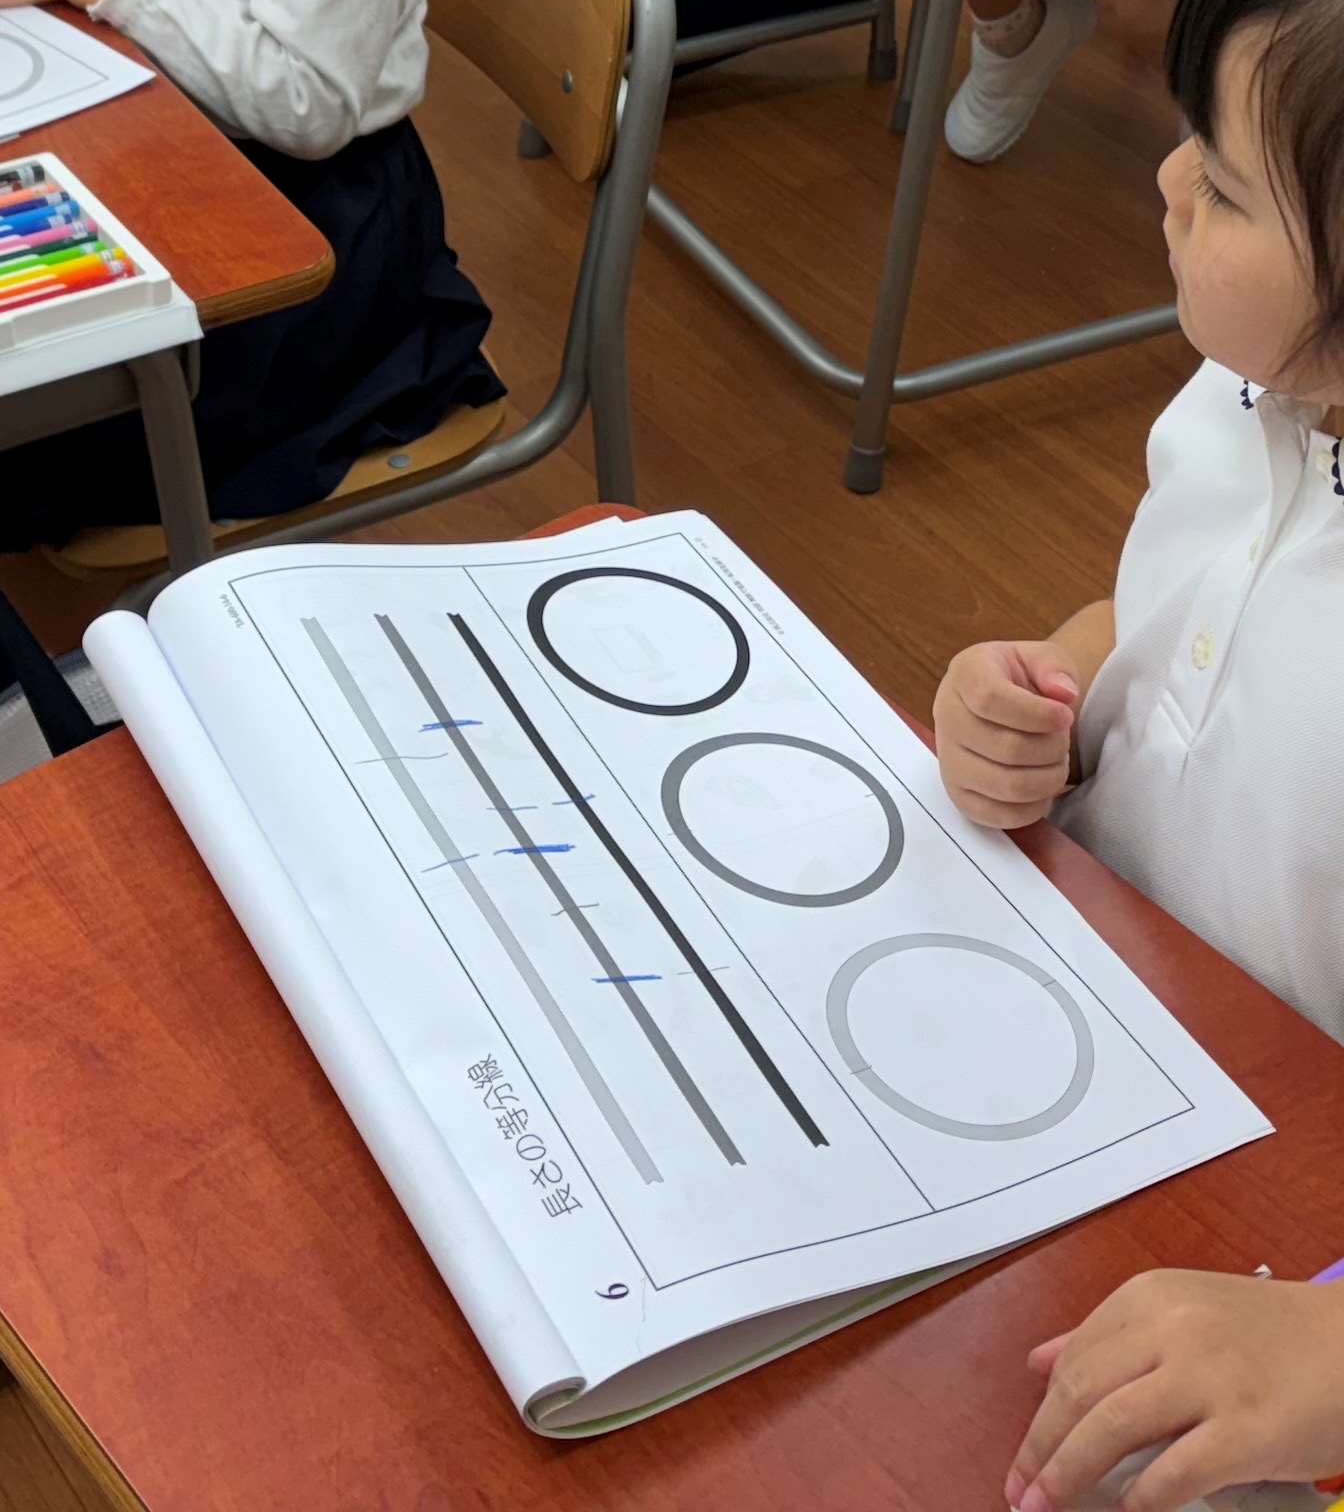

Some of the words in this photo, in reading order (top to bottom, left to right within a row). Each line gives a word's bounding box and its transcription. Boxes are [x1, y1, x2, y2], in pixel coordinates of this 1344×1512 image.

[466, 1052, 584, 1219] 長さの等分線
